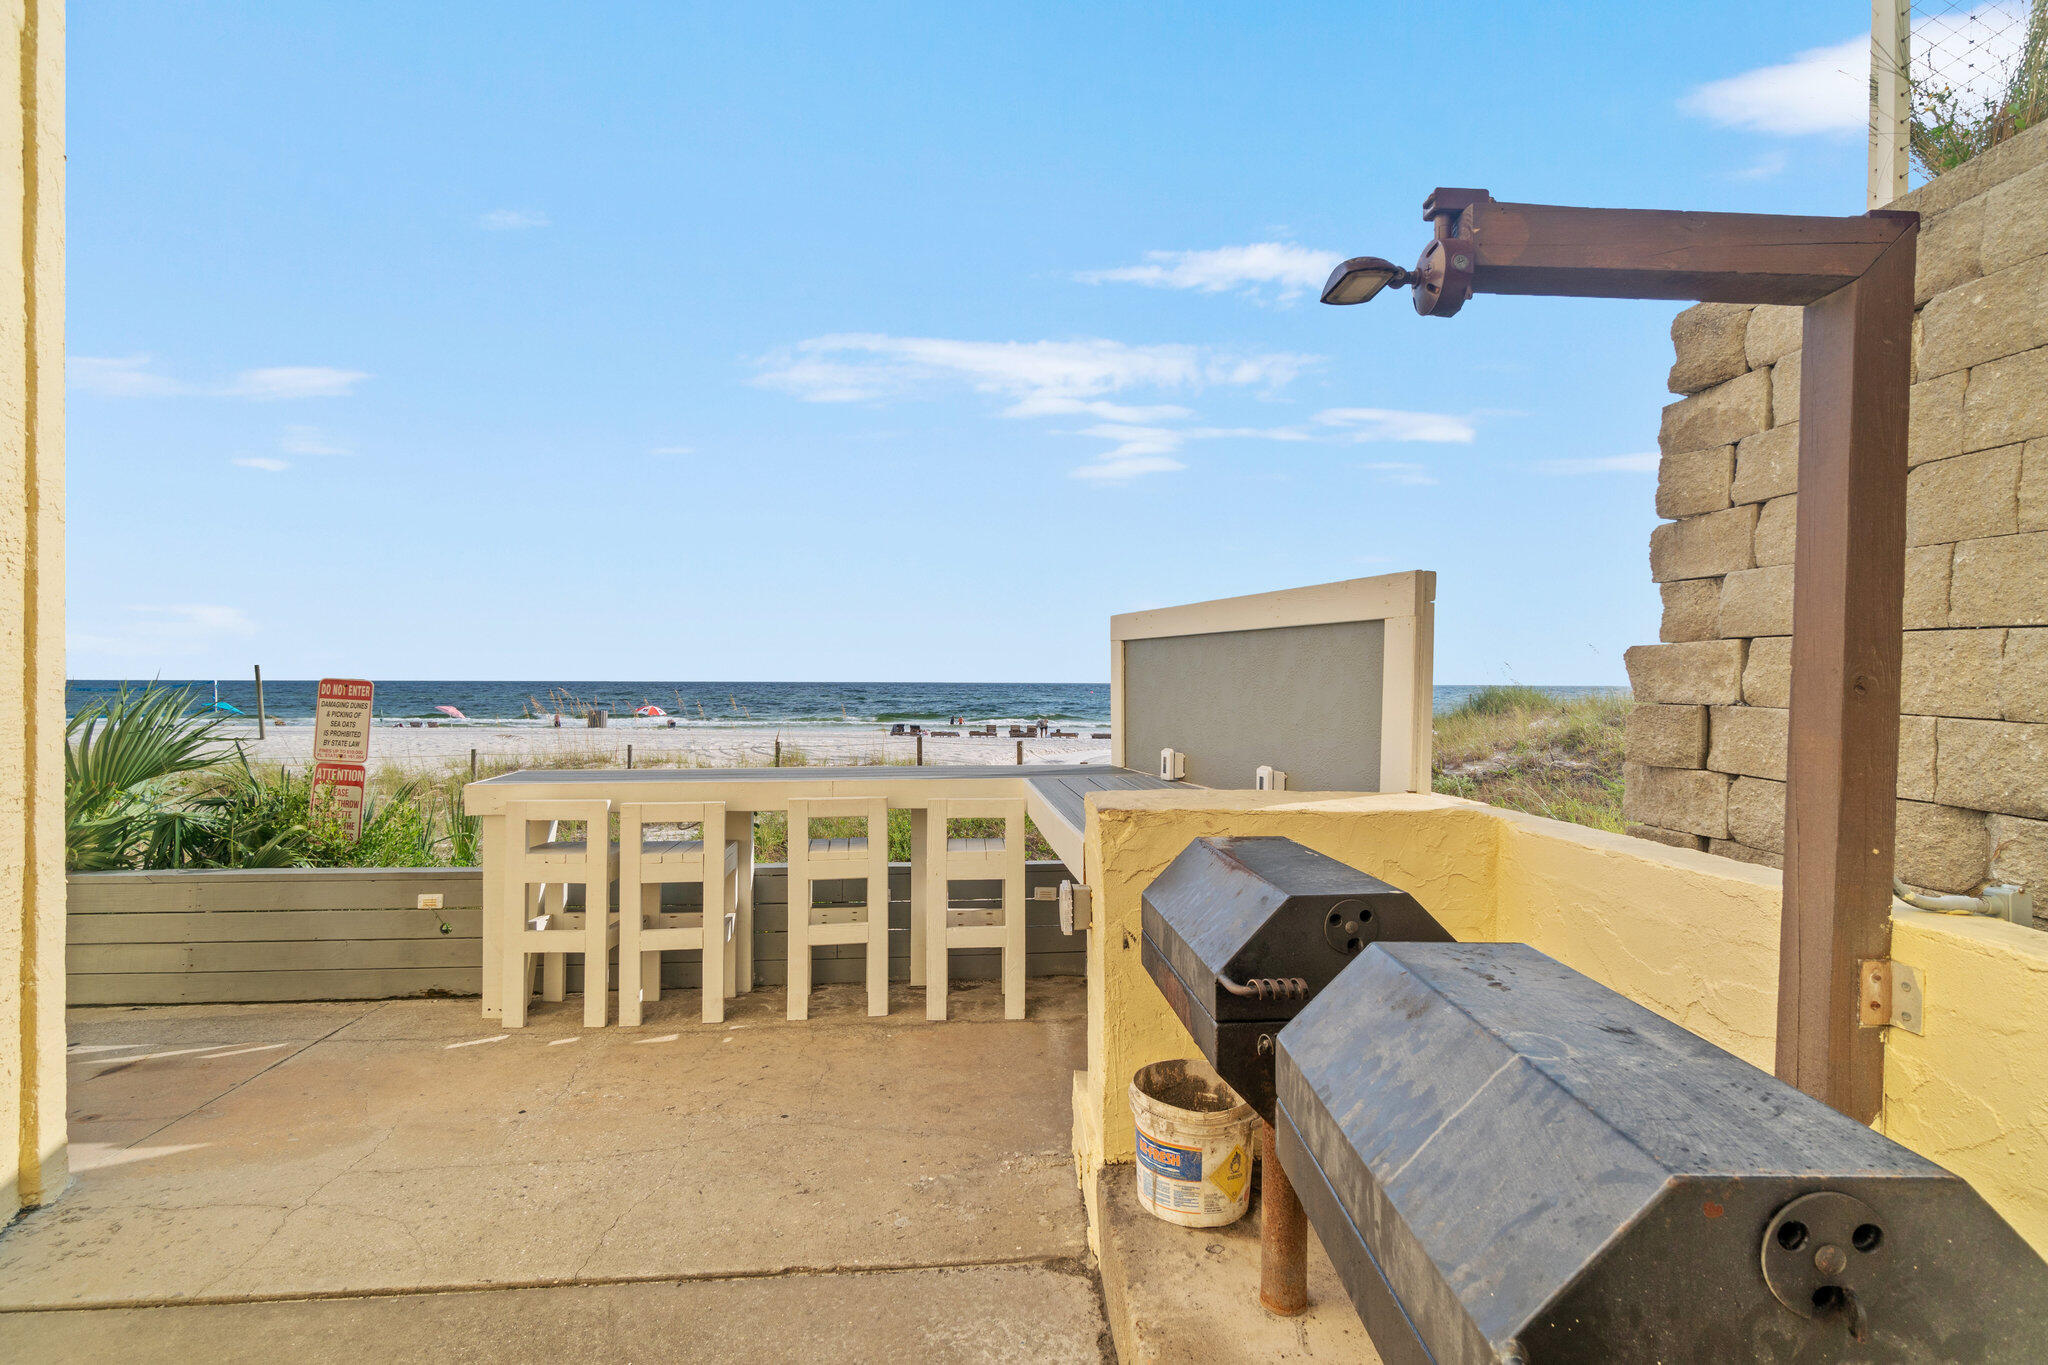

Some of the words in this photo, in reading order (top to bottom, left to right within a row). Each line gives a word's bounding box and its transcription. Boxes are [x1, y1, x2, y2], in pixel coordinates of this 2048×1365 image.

[321, 684, 331, 695] DO
[333, 684, 347, 696] NOT
[348, 685, 371, 697] ENTER
[321, 700, 349, 708] DAMAGING
[316, 768, 364, 782] ATTENTION
[337, 800, 360, 808] THROW
